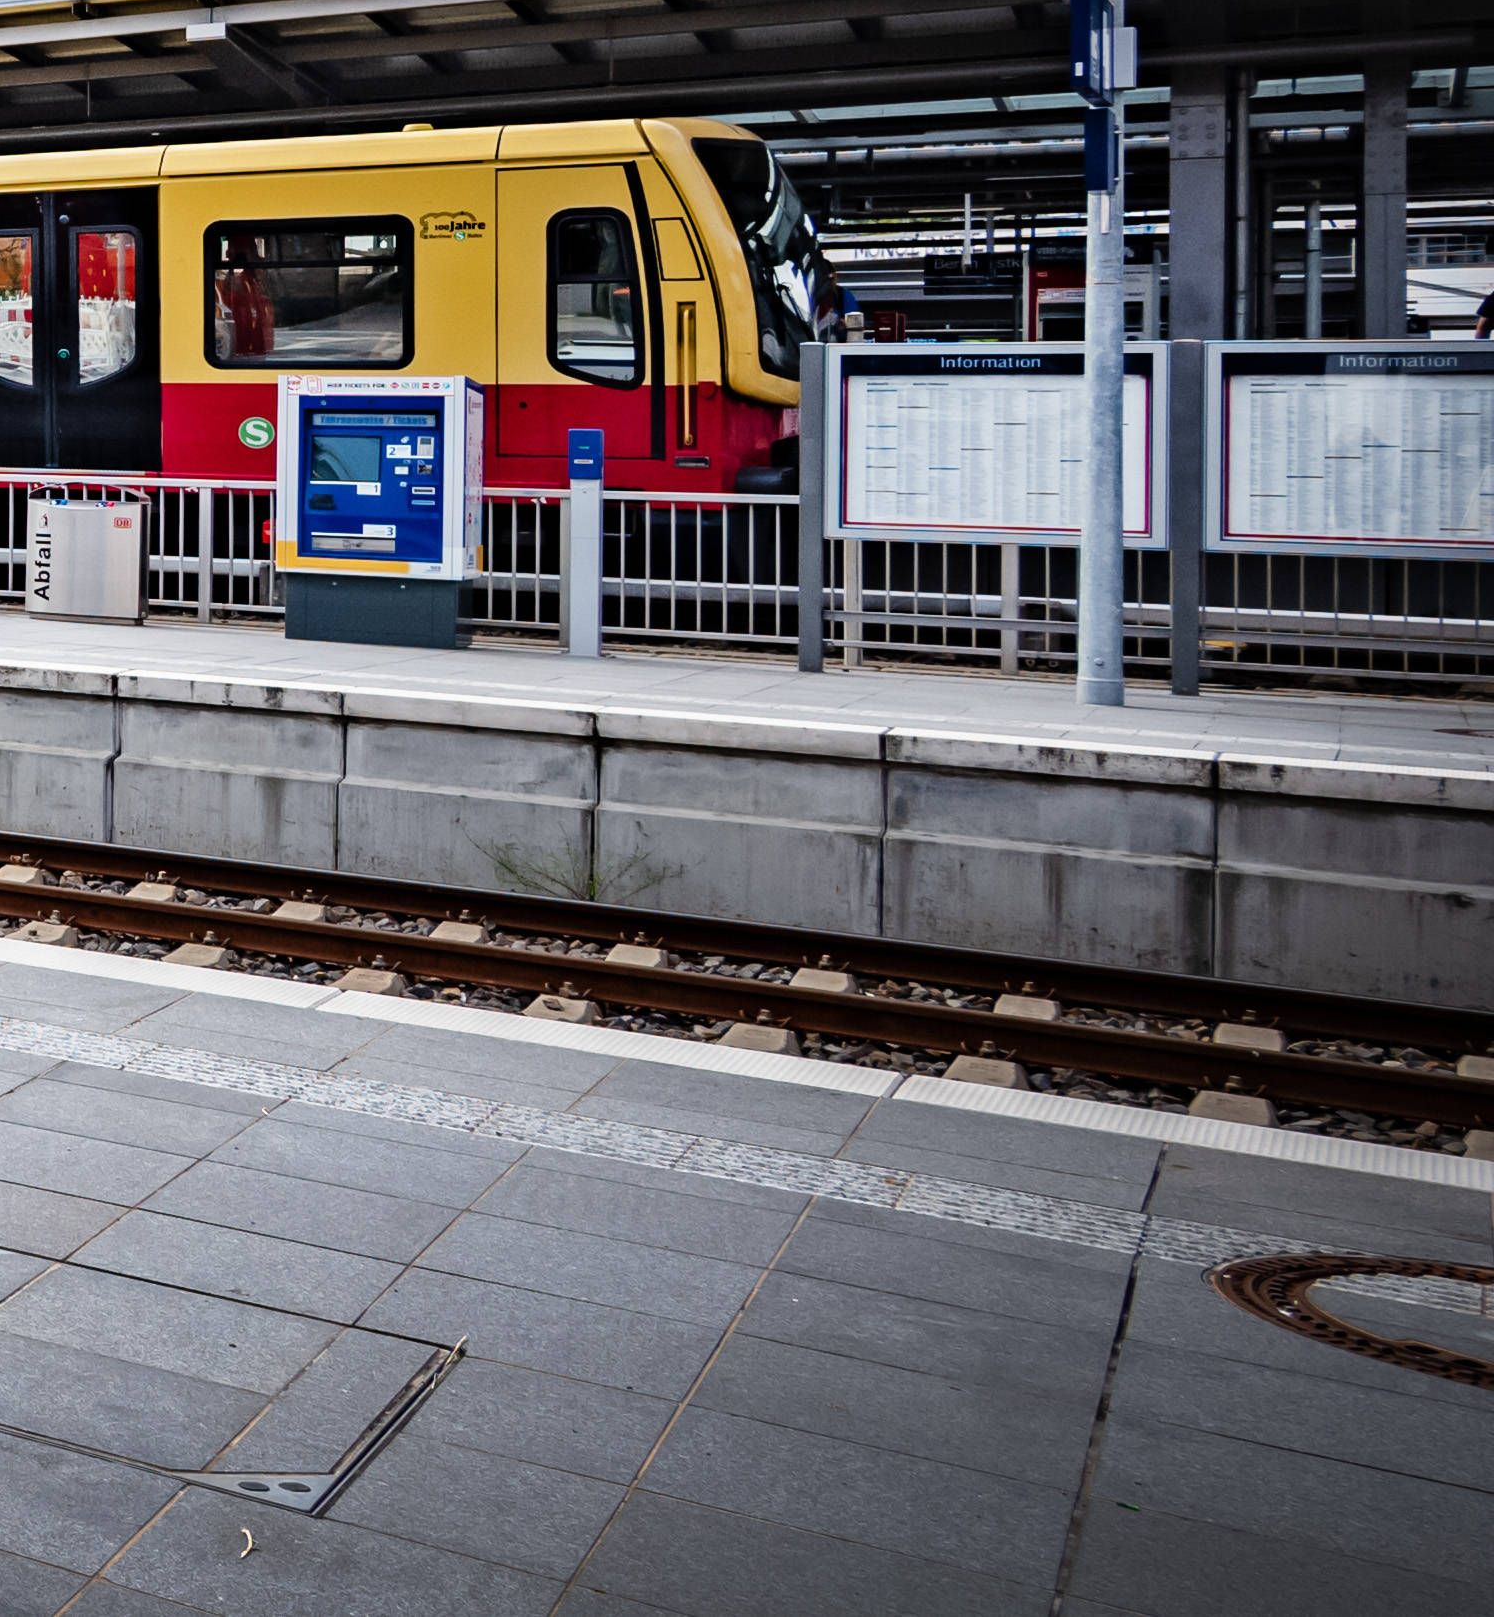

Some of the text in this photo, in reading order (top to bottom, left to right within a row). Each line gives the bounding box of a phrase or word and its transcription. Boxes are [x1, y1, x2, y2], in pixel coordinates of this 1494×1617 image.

[449, 221, 486, 232] Jahre
[941, 356, 1041, 370] Information
[1339, 355, 1458, 368] Information
[246, 420, 269, 445] S
[389, 447, 396, 456] 2
[386, 527, 393, 536] 3
[34, 533, 52, 601] Abfall
